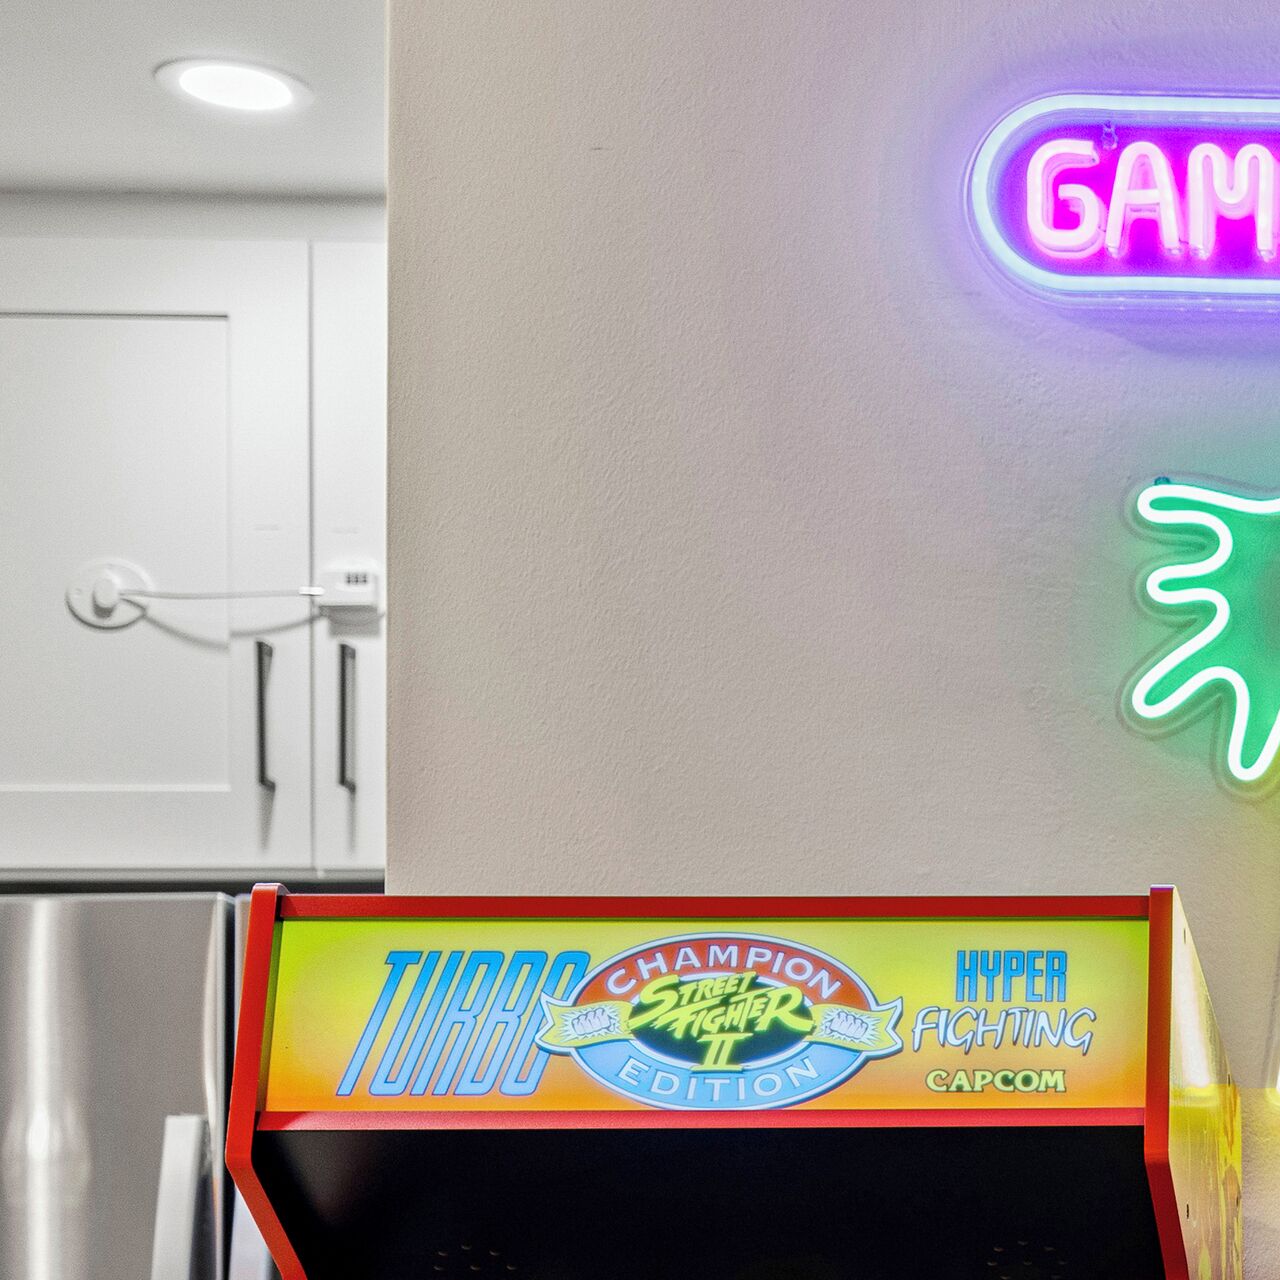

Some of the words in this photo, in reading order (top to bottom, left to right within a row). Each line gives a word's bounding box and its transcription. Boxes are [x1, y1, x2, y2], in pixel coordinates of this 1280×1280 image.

[605, 943, 842, 1000] CHAMPION
[955, 949, 1068, 1003] HYPER
[335, 949, 592, 1097] TURBO
[630, 971, 757, 1026] STREET
[651, 986, 815, 1039] FIGHTER
[690, 1032, 754, 1072] II
[911, 1006, 1097, 1057] FIGHTING
[617, 1055, 821, 1102] EDITION
[926, 1069, 1067, 1093] CAPCOM
